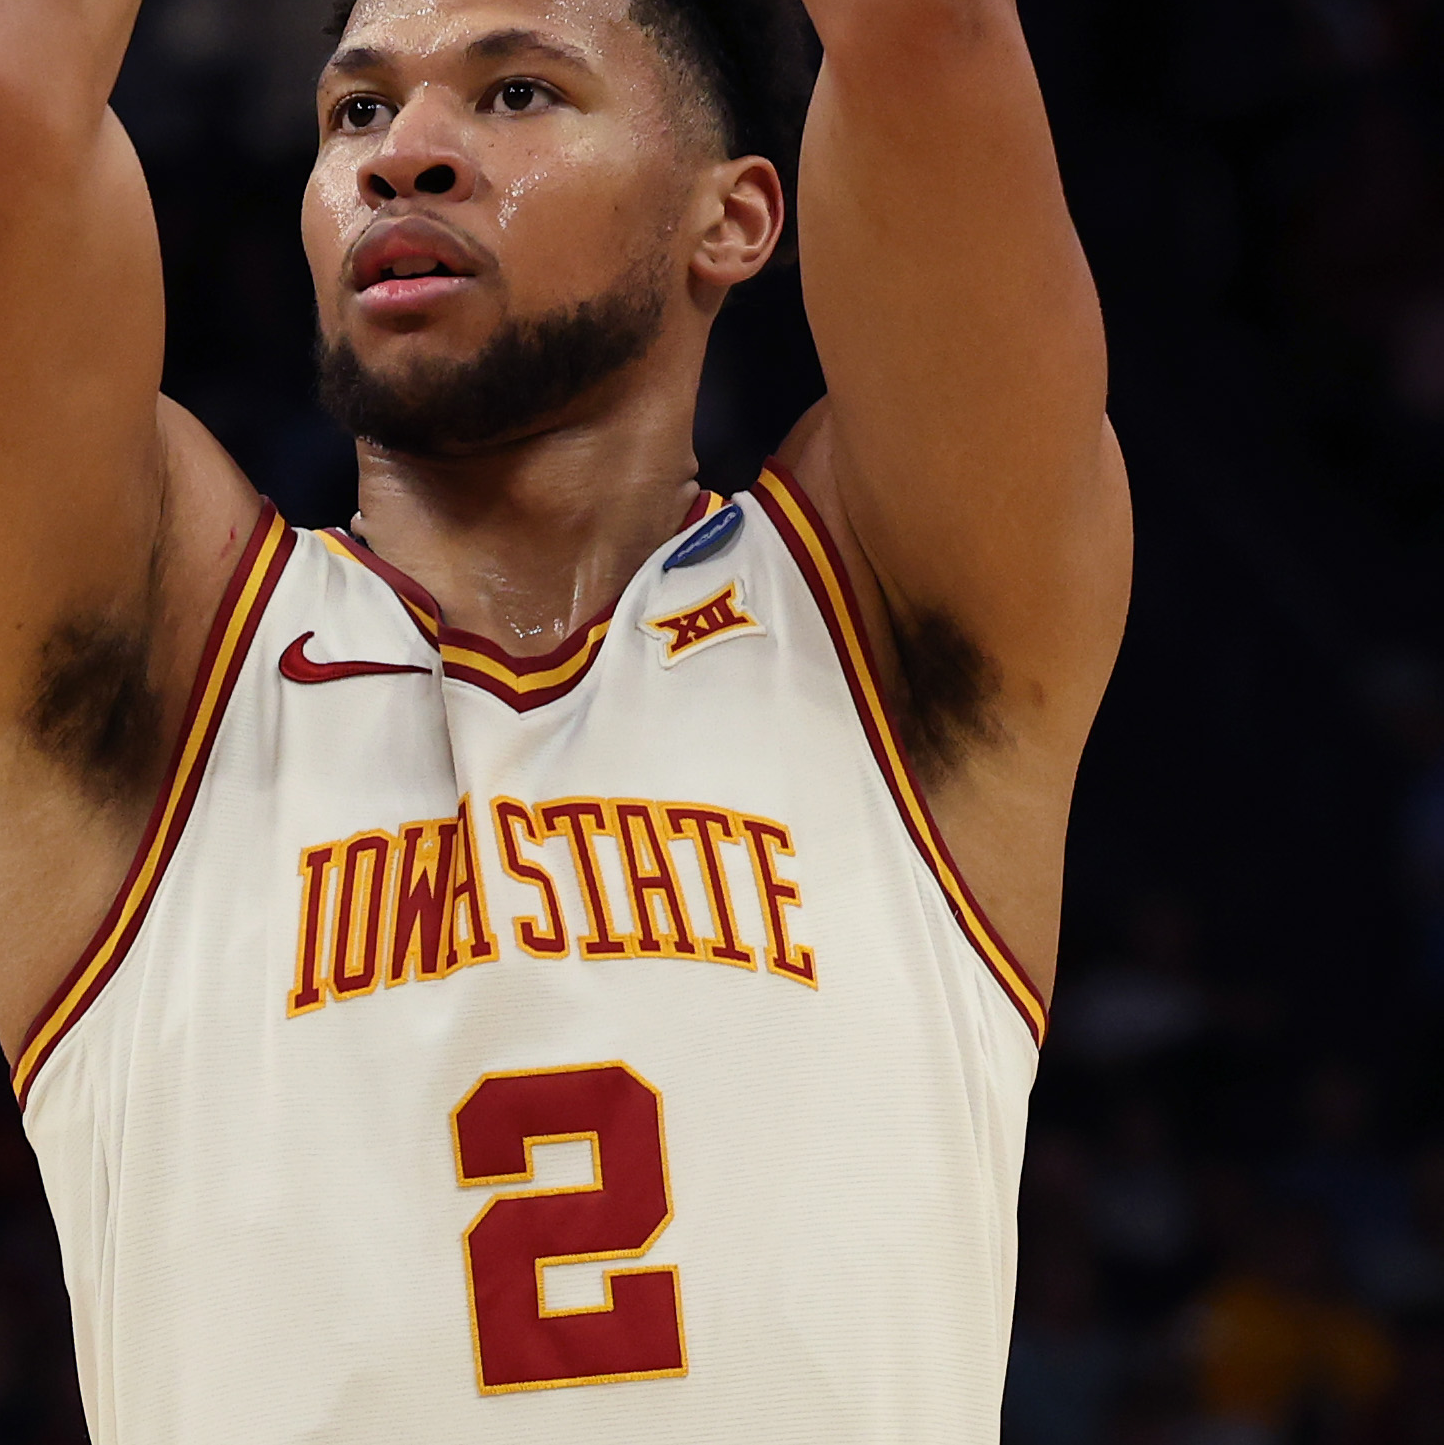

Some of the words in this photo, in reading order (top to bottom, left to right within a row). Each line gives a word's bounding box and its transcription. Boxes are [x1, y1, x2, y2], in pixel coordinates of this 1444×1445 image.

[648, 582, 756, 658] XII
[286, 793, 500, 1018] IOWA
[490, 795, 818, 990] STATE
[448, 1059, 688, 1396] 2
